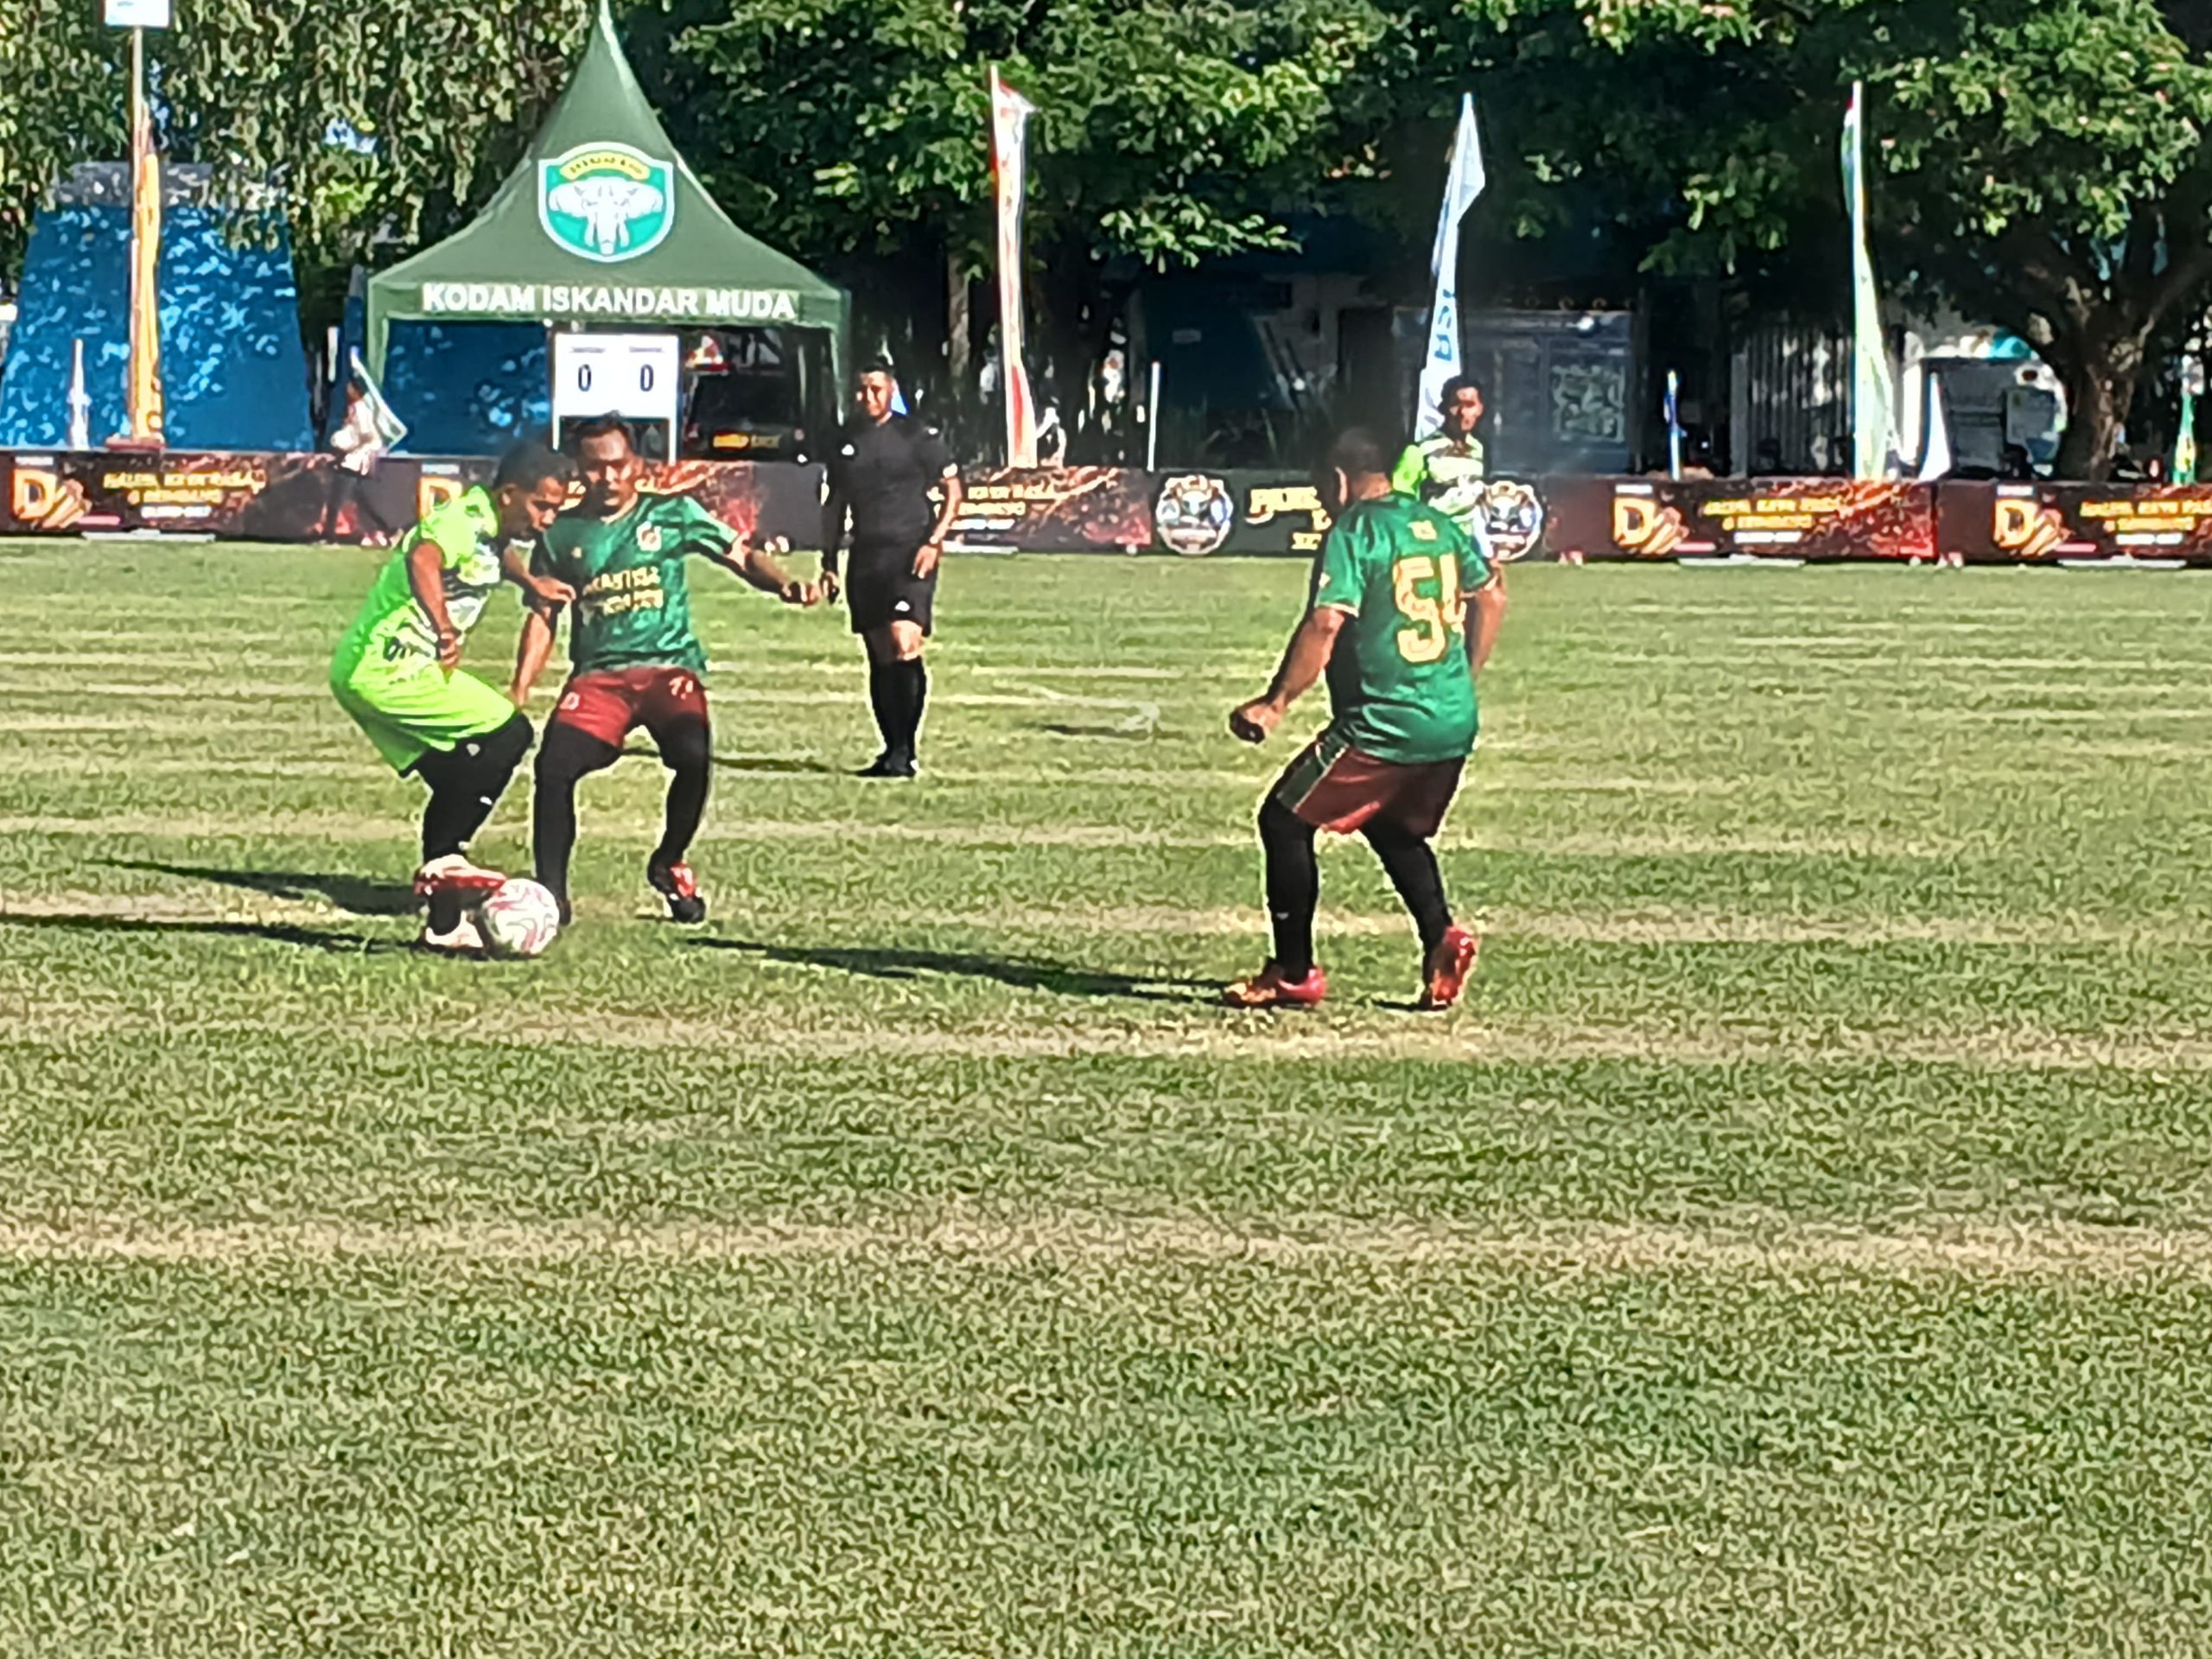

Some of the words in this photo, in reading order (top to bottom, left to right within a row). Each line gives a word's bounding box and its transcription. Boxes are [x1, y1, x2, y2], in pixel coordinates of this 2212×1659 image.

[423, 283, 535, 312] KODAM
[543, 285, 698, 315] ISKANDAR
[706, 289, 796, 318] MUDA
[578, 364, 592, 392] 0
[640, 364, 654, 392] 0
